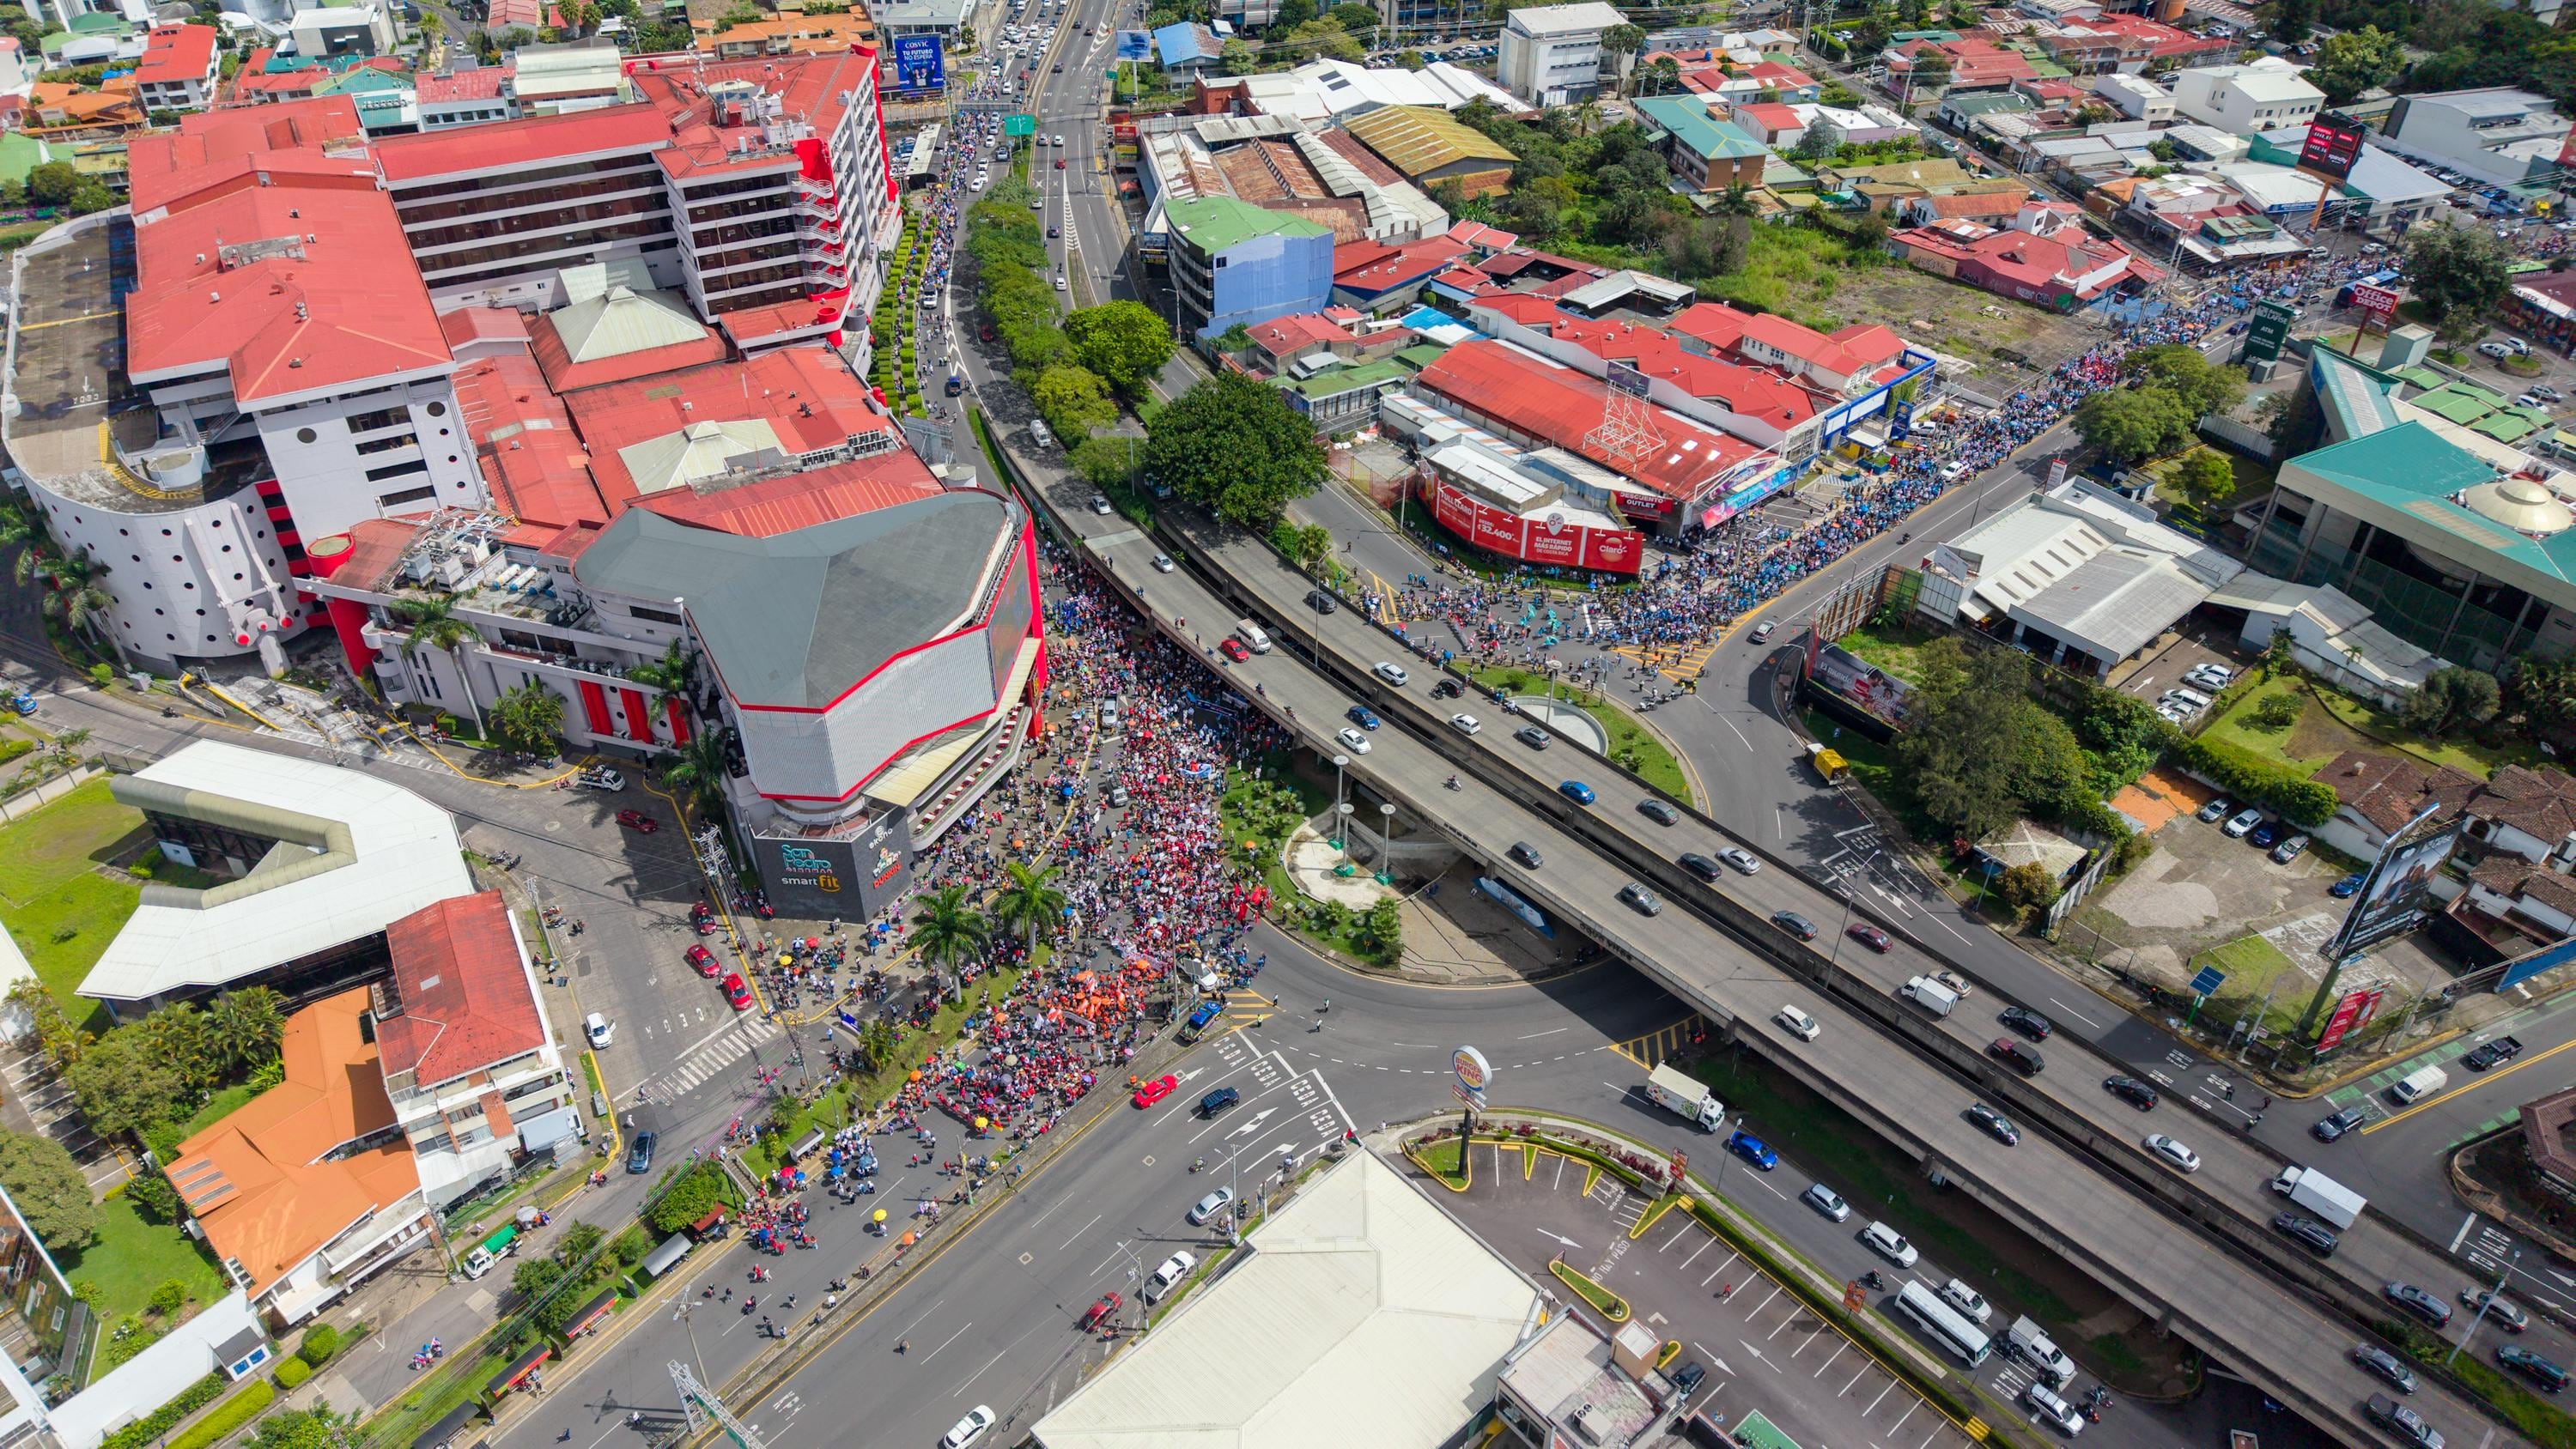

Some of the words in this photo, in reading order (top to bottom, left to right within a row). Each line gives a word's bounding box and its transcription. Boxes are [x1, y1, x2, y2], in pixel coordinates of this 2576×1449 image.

[2354, 287, 2394, 305] Office
[2355, 296, 2391, 312] DEPOT
[2267, 313, 2288, 324] LAFISE
[1441, 493, 1454, 504] FULL
[1455, 500, 1473, 515] CLARO
[1626, 500, 1656, 508] OUTLET
[1549, 543, 1572, 552] RÁPIDO
[1599, 544, 1623, 555] Claro
[781, 845, 815, 859] San
[783, 857, 831, 869] Pedro
[819, 875, 839, 888] fit
[1212, 1036, 1246, 1067] CEDA
[2166, 1049, 2193, 1070] KPH
[1456, 1057, 1481, 1073] BURGER
[1456, 1064, 1483, 1083] KING
[1250, 1061, 1281, 1088] CEDA
[1291, 1079, 1319, 1107] CEDA
[1309, 1109, 1339, 1137] CEDA
[2478, 1228, 2511, 1257] ALTO
[1590, 1271, 1603, 1282] NO
[1599, 1258, 1614, 1274] HAY
[1613, 1240, 1630, 1259] PASO
[1991, 1367, 2026, 1401] ALTO
